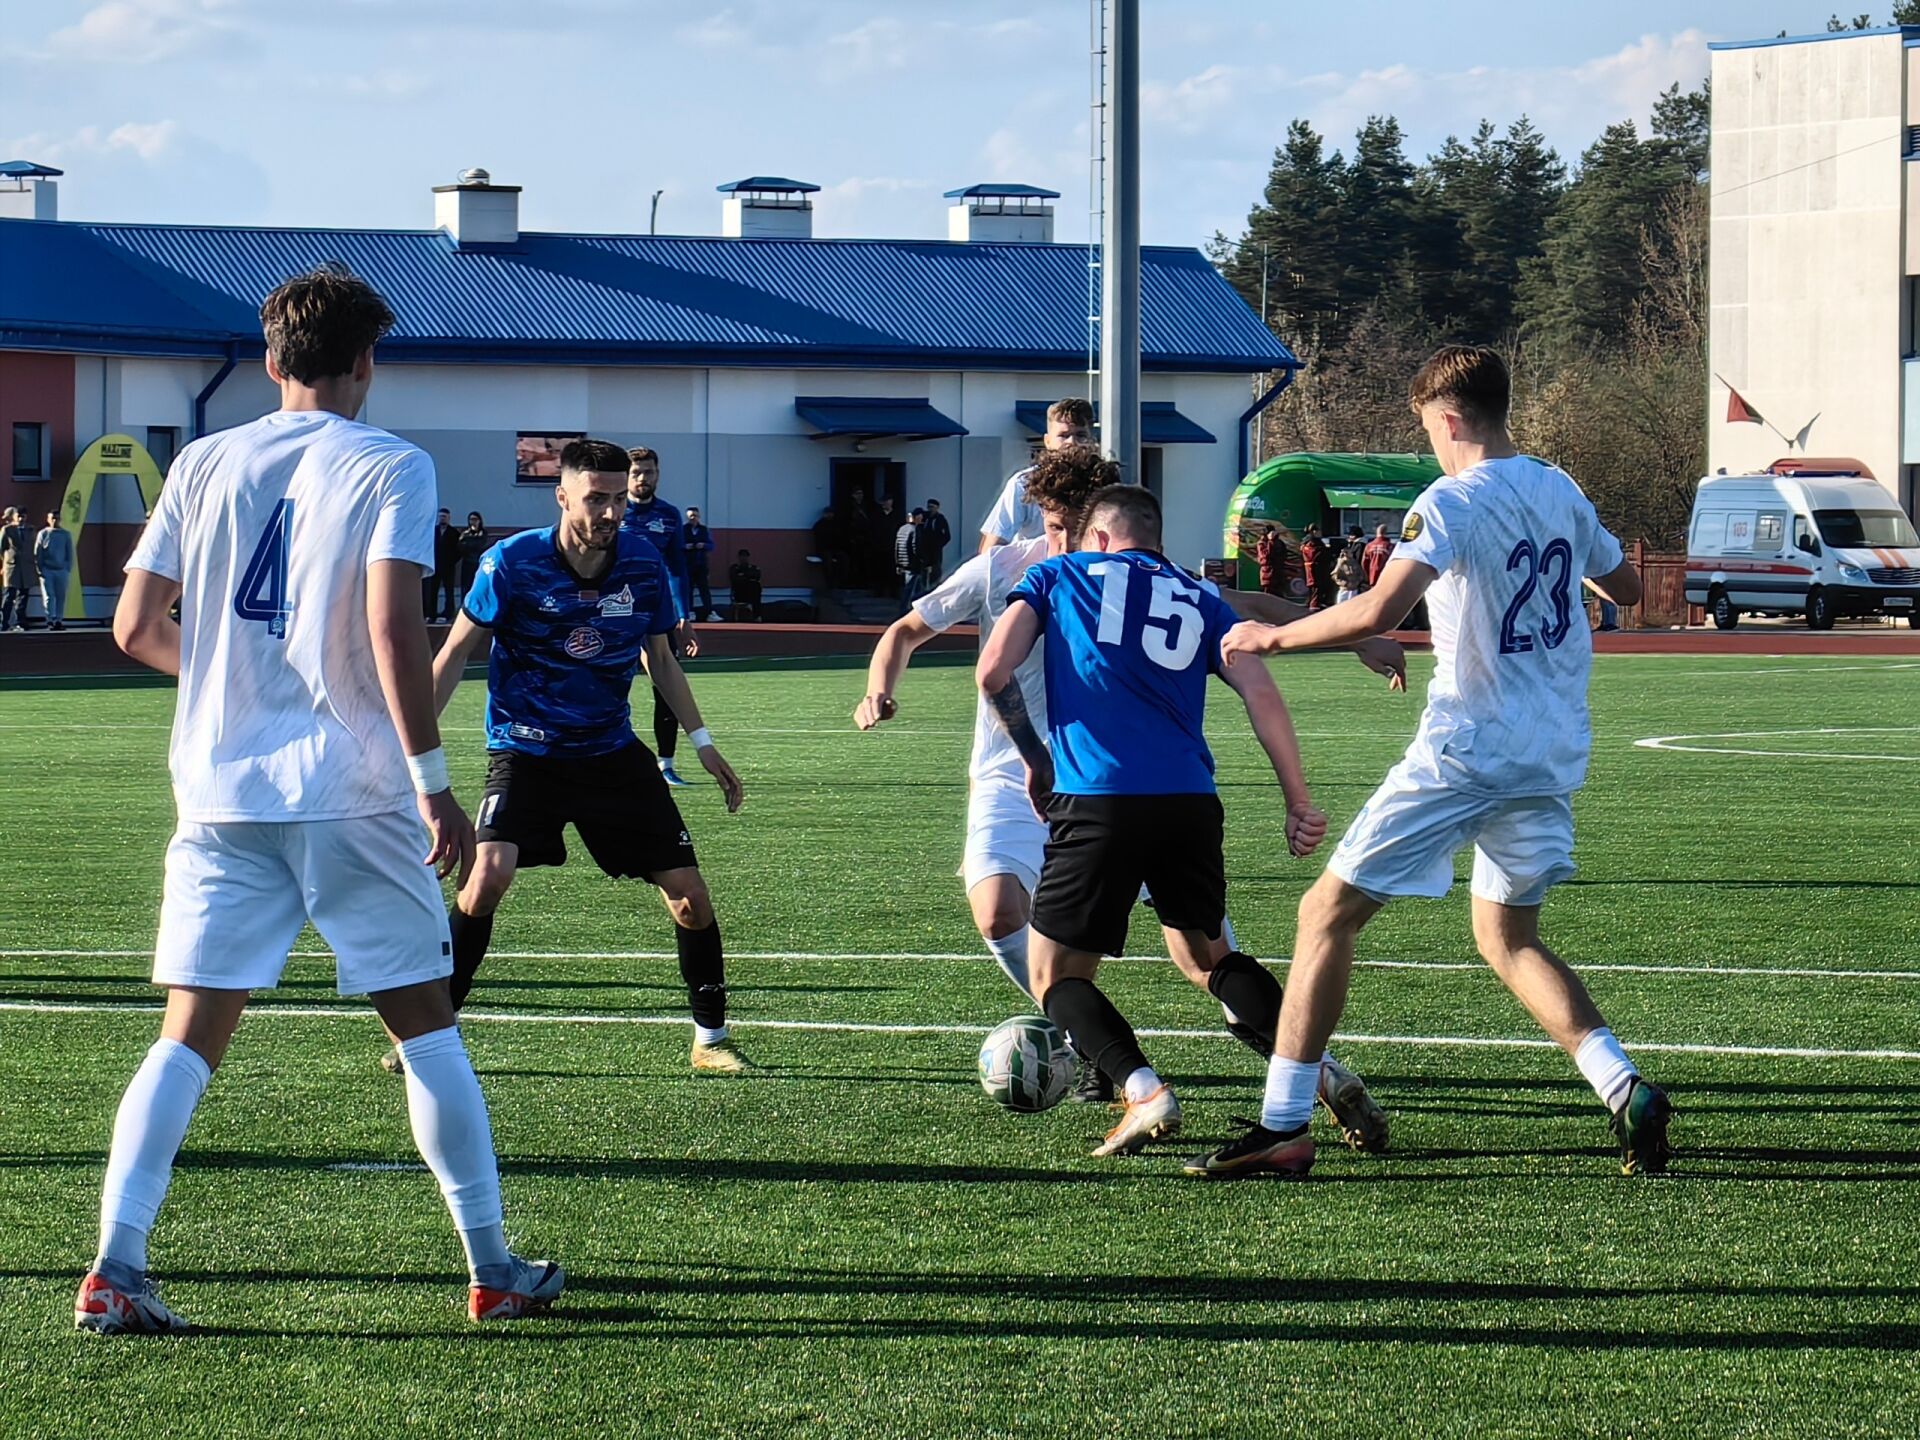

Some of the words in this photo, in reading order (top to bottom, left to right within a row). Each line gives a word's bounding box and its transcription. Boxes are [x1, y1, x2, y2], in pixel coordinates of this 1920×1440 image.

[234, 497, 296, 640] 4
[1087, 560, 1205, 671] 15
[1499, 537, 1572, 654] 23
